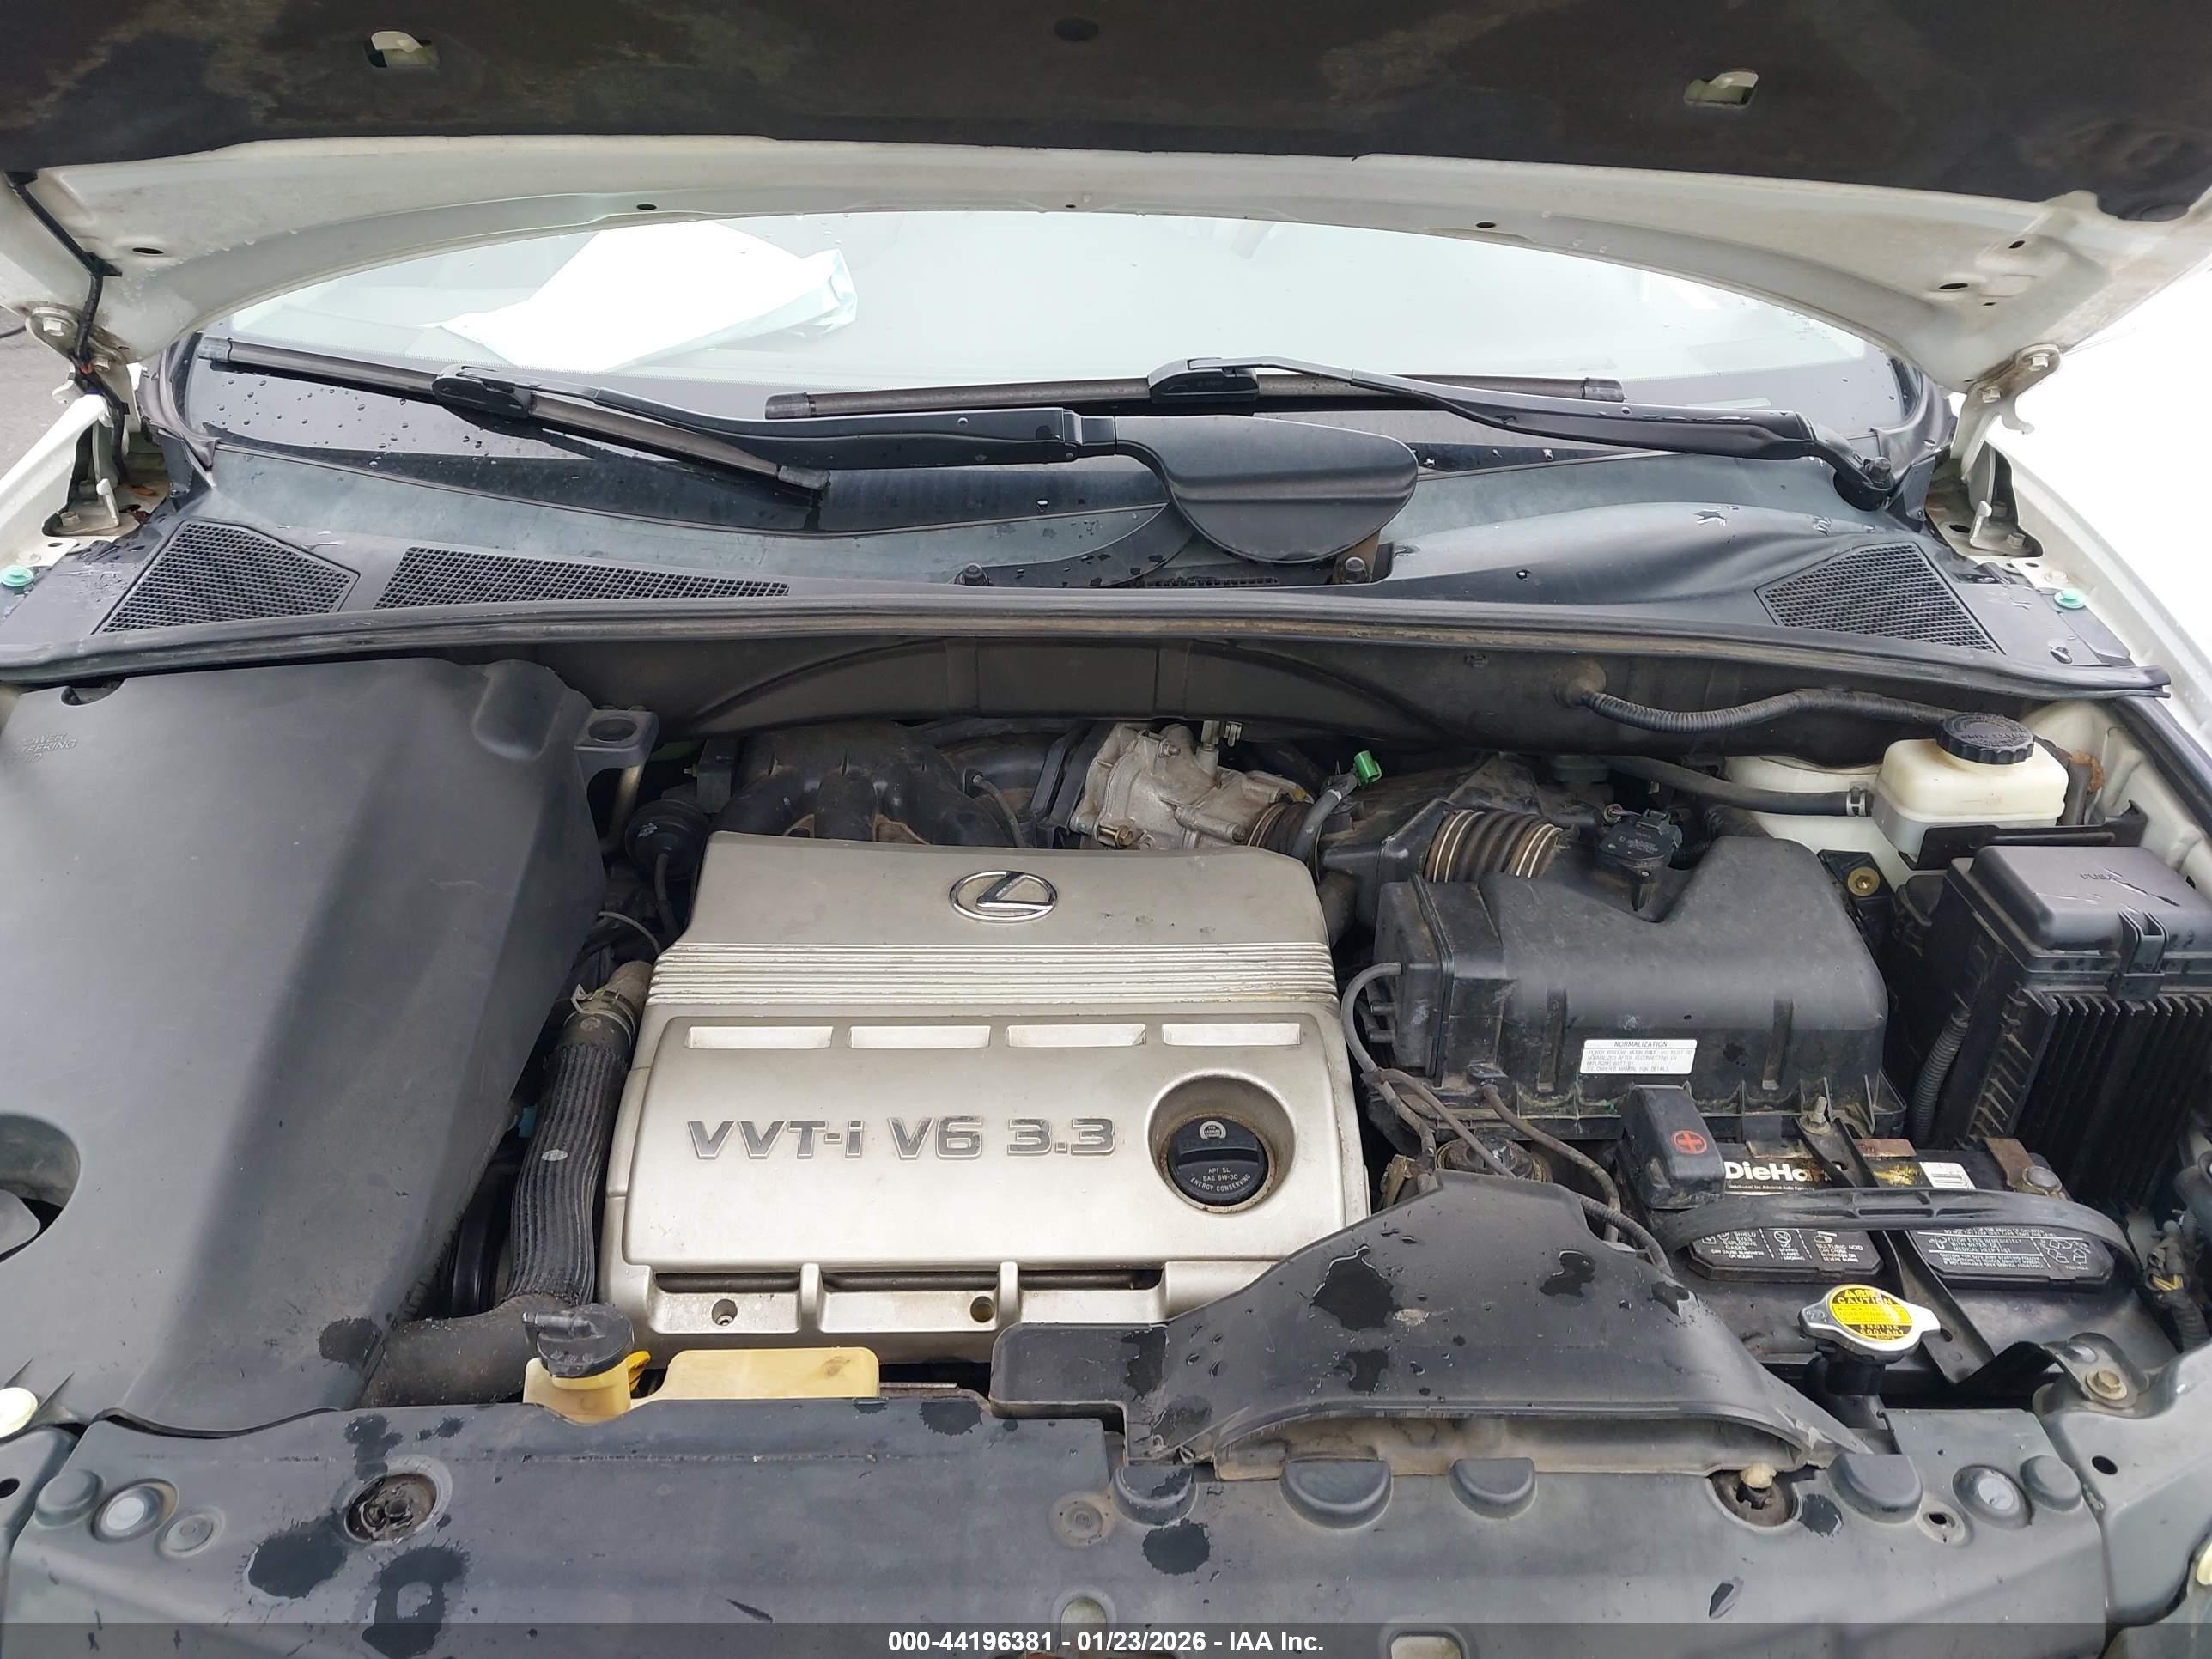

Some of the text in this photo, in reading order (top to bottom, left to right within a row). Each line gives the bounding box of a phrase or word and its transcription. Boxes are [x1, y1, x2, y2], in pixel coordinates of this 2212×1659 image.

[687, 1115, 1116, 1160] VVT-i V6 3.3
[1723, 1161, 1832, 1182] DieHa
[1190, 1174, 1251, 1192] ENERGY CONSERVING
[1838, 1297, 1893, 1305] CAUTION
